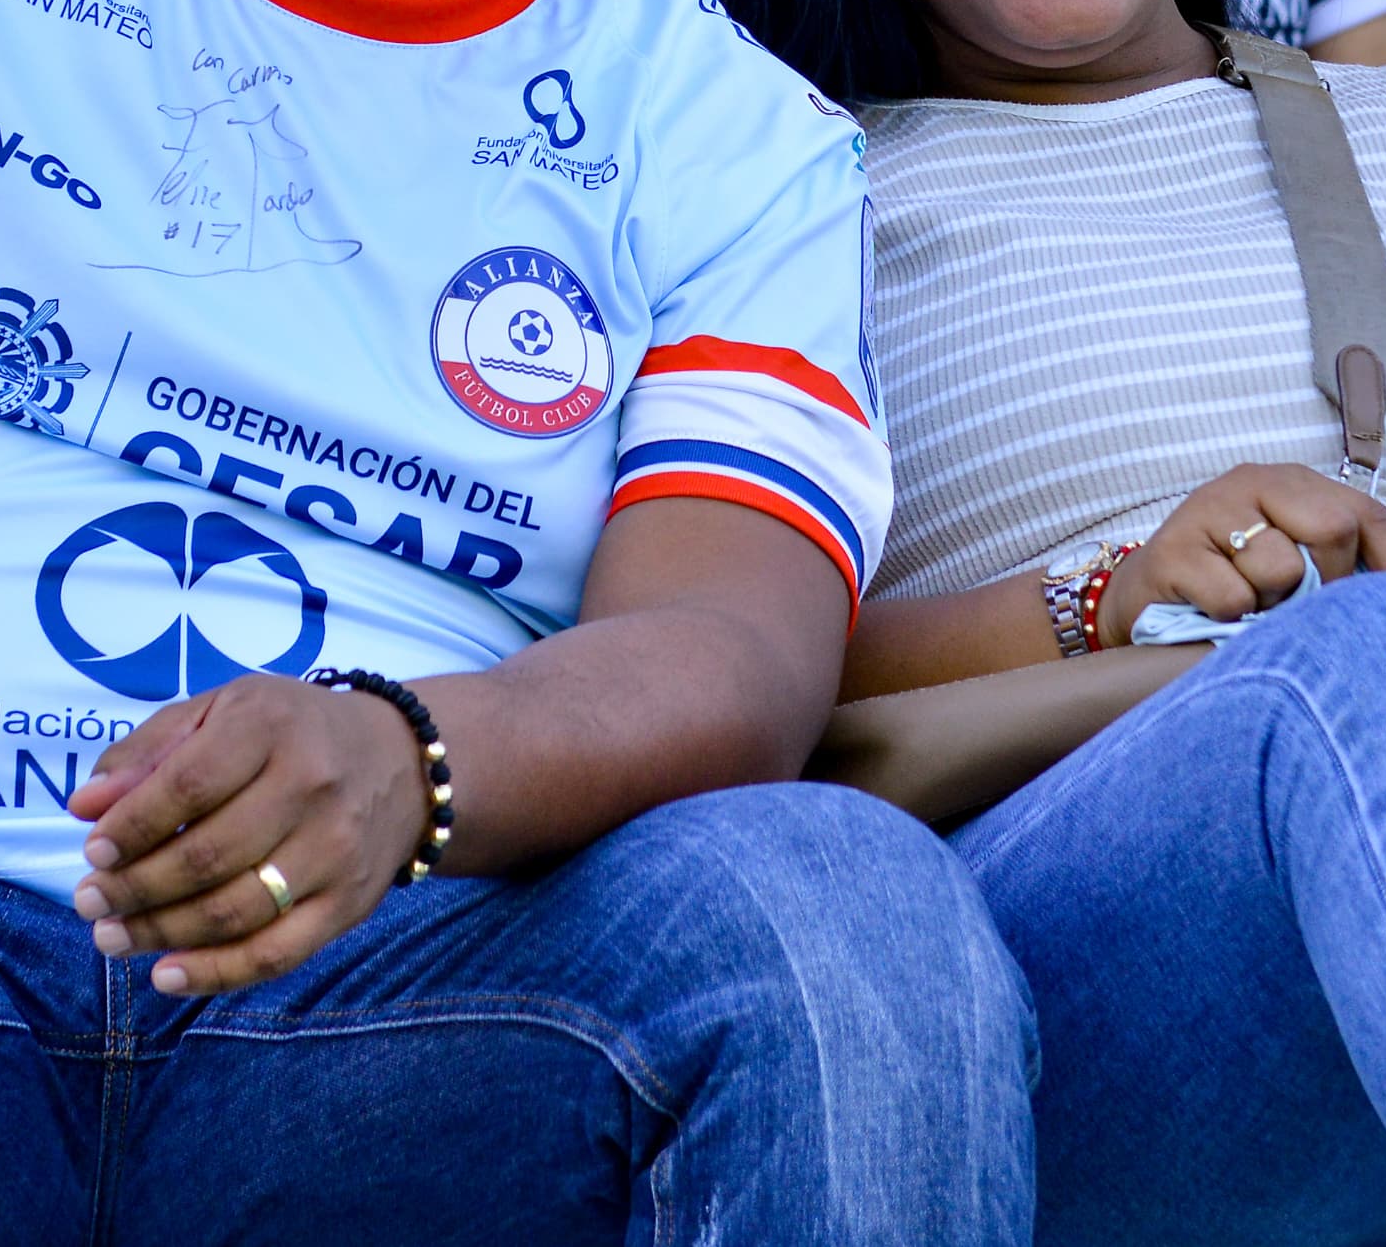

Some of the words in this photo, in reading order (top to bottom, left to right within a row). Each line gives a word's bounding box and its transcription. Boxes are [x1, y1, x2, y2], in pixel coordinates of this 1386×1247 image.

[529, 145, 619, 191] MATEO
[464, 256, 594, 328] ALIANZA
[453, 368, 534, 427] FÚTBOL
[542, 391, 593, 427] CLUB
[146, 375, 456, 504] GOBERNACIÓN
[464, 480, 542, 531] DEL
